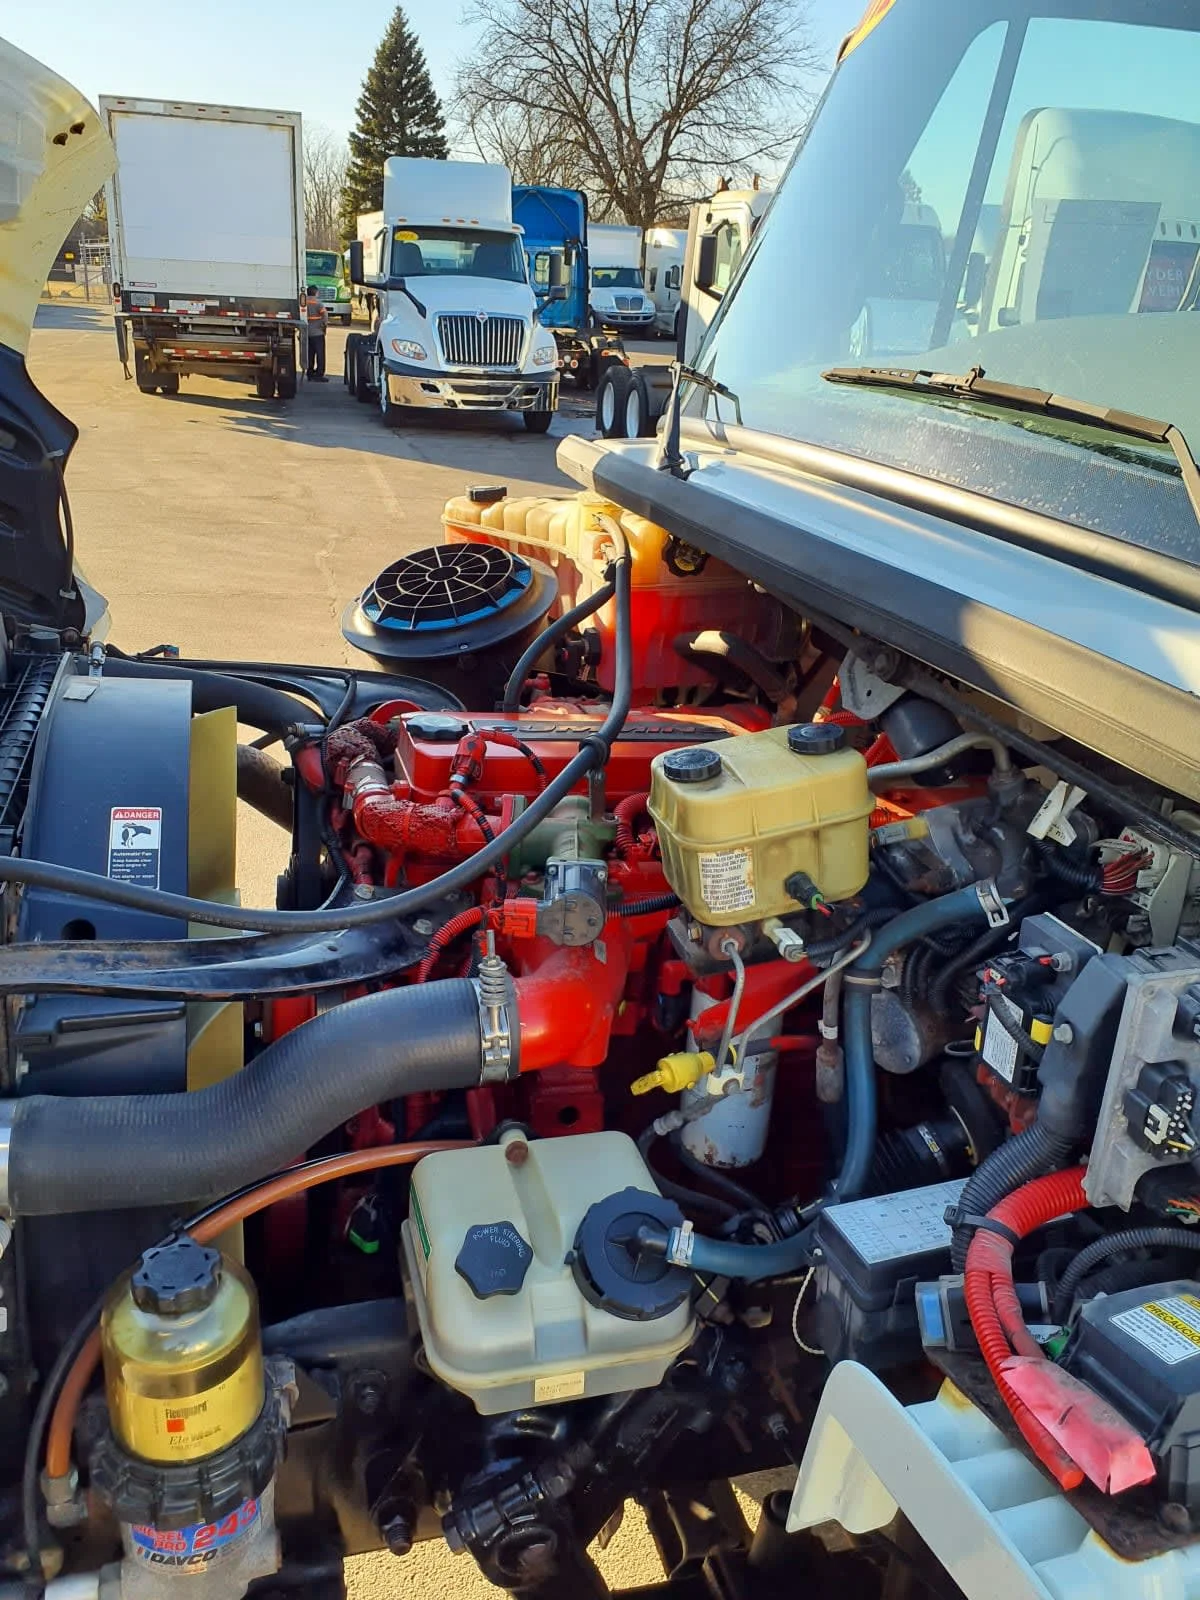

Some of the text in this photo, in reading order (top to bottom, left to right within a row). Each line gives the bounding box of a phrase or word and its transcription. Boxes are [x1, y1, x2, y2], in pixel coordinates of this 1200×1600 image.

[1147, 269, 1184, 281] YDER
[124, 811, 159, 819] DANGER
[472, 1226, 527, 1258] POWER STEERING
[490, 1235, 511, 1248] FLUID
[192, 1498, 258, 1550] 243
[132, 1524, 183, 1540] DIESEL
[154, 1539, 187, 1553] PRO
[150, 1548, 218, 1566] DAVCO
